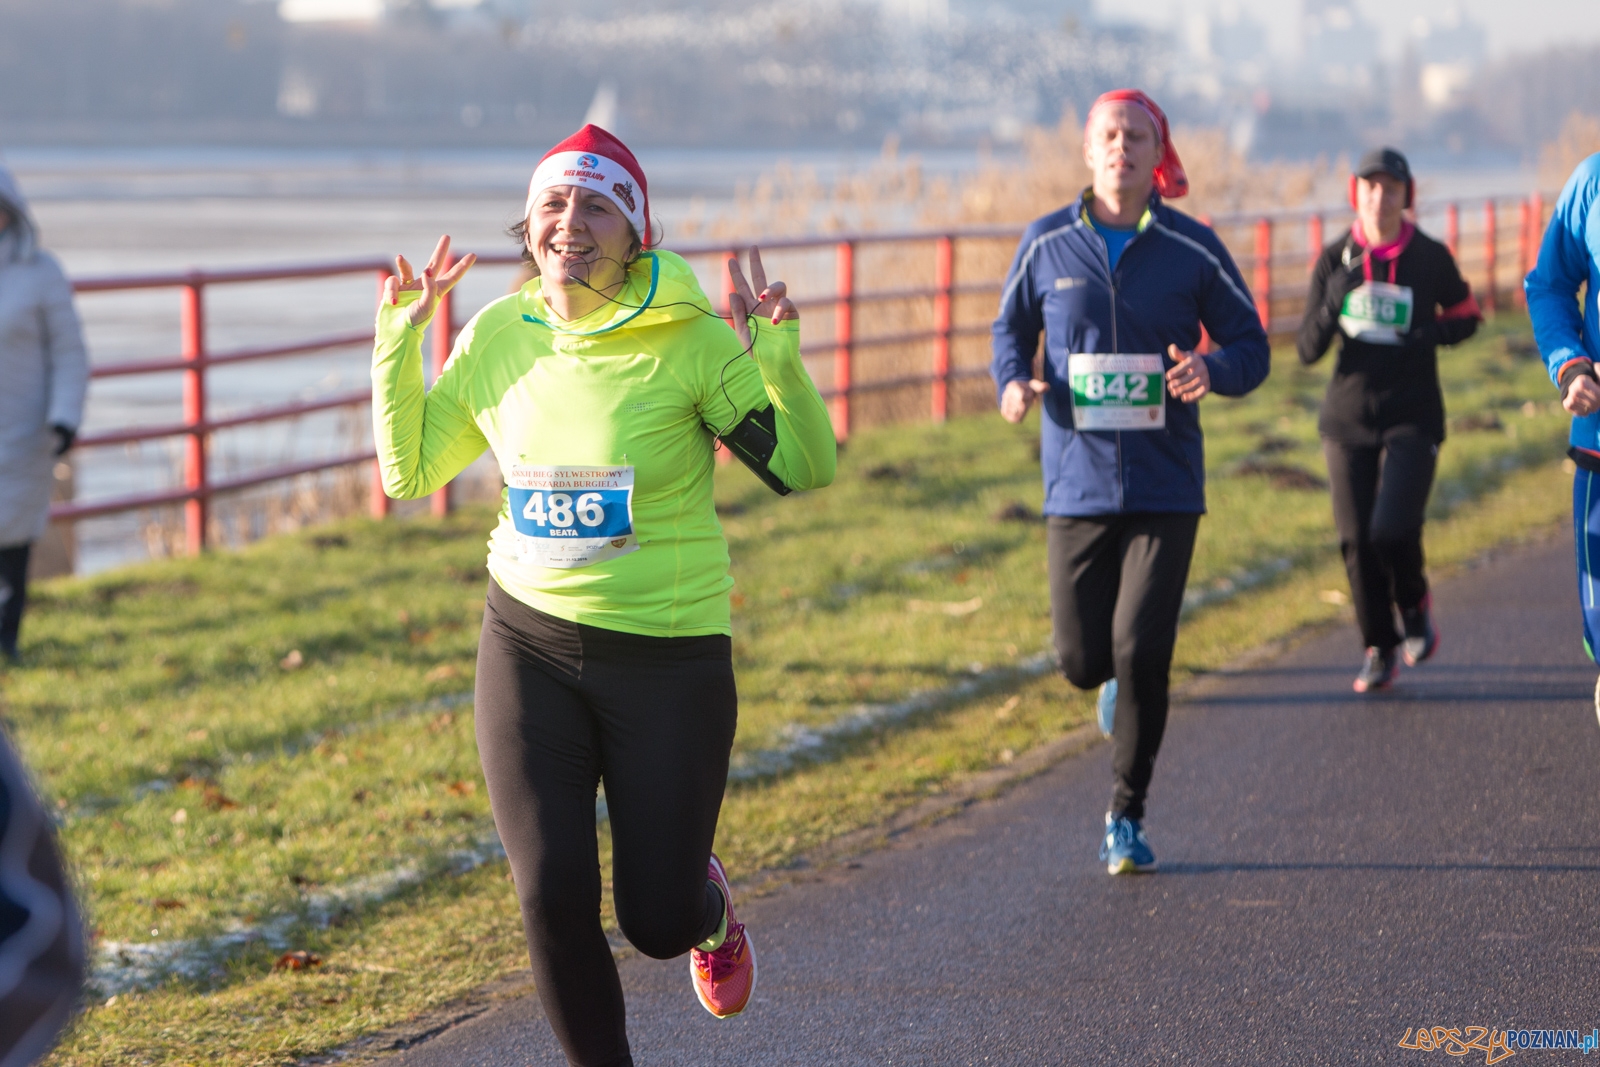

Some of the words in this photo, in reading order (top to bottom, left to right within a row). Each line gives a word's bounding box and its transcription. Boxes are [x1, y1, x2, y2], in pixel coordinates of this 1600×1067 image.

[576, 169, 606, 181] MIKOŁAJÓW
[1085, 373, 1149, 400] 842
[533, 470, 553, 478] BIEG
[554, 470, 623, 478] SYLWESTROWY
[527, 480, 571, 488] RYSZARDA
[573, 480, 619, 488] BURGIELA
[522, 491, 605, 528] 486
[549, 529, 578, 537] BEATA
